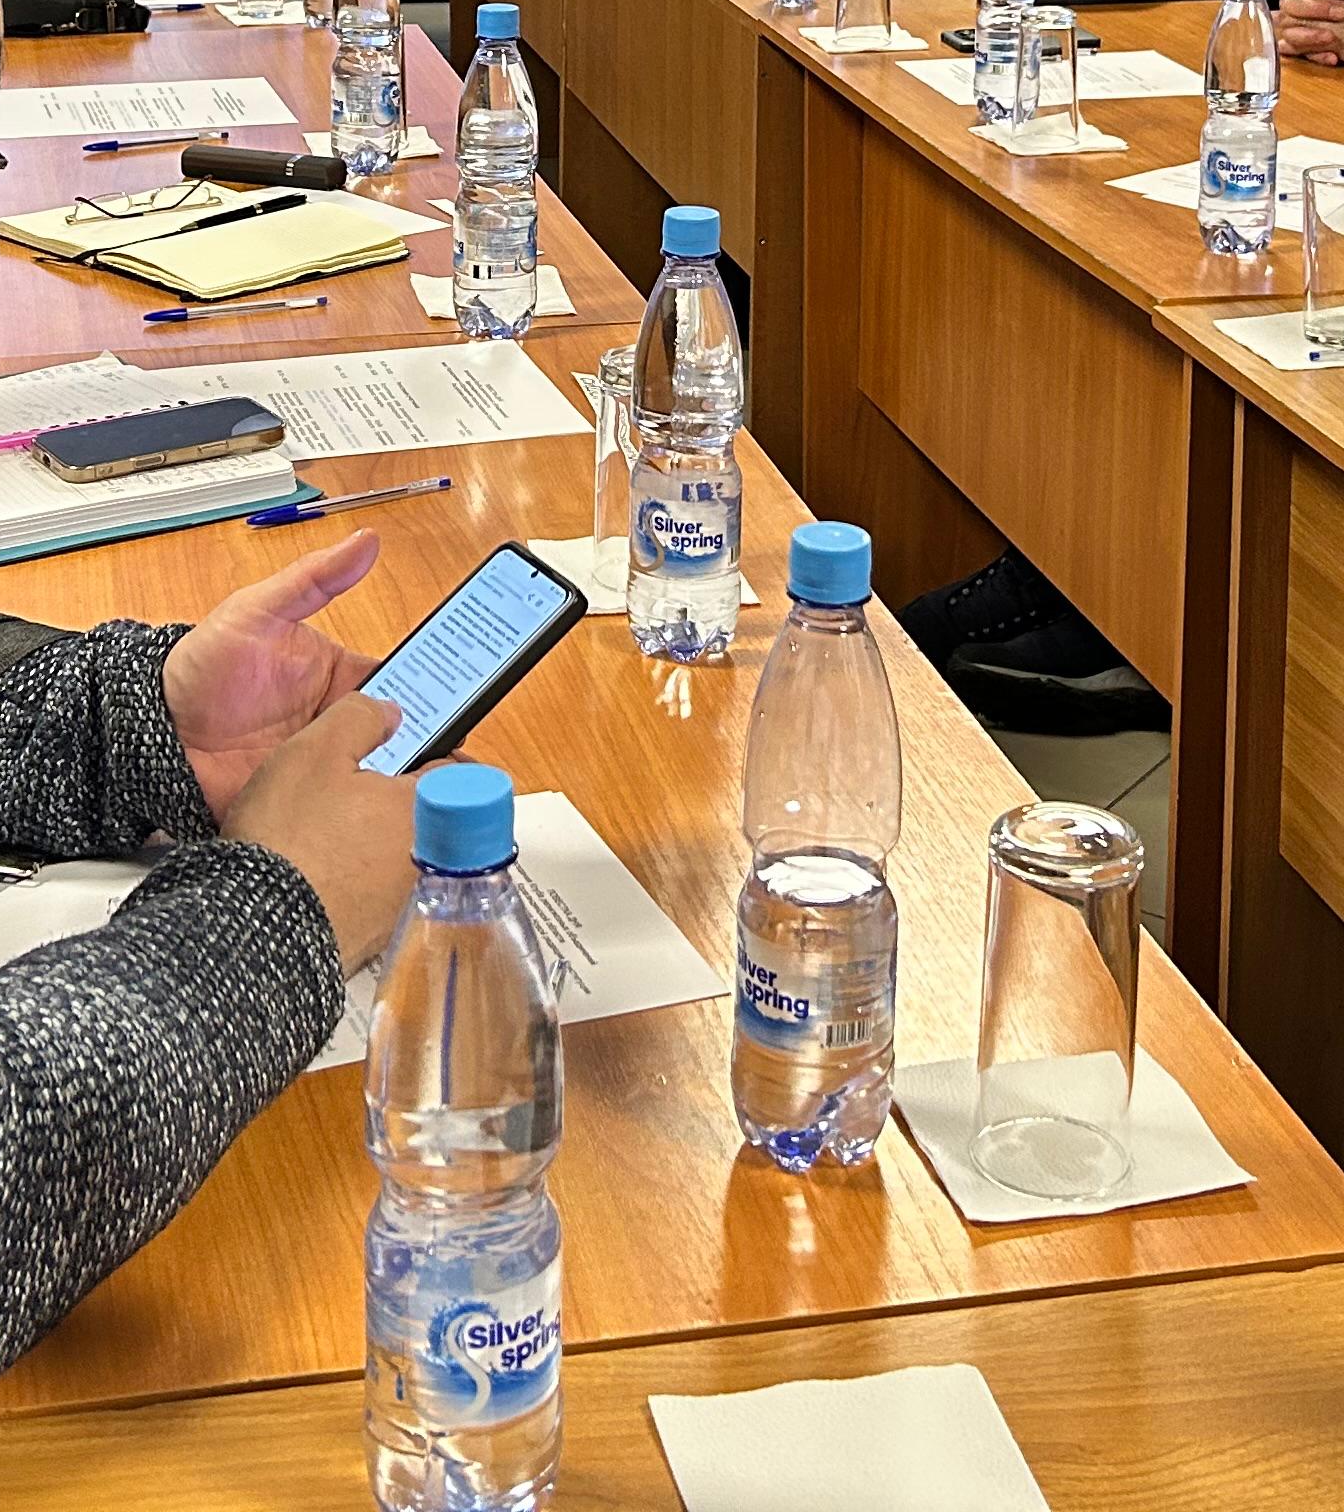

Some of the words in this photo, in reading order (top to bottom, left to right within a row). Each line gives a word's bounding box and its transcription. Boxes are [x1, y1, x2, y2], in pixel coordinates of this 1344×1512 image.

[1217, 160, 1251, 173] Silver
[1229, 171, 1265, 185] spring
[654, 516, 703, 534] Silver
[671, 533, 723, 549] spring
[744, 977, 810, 1019] spring
[467, 1306, 544, 1349] Silver
